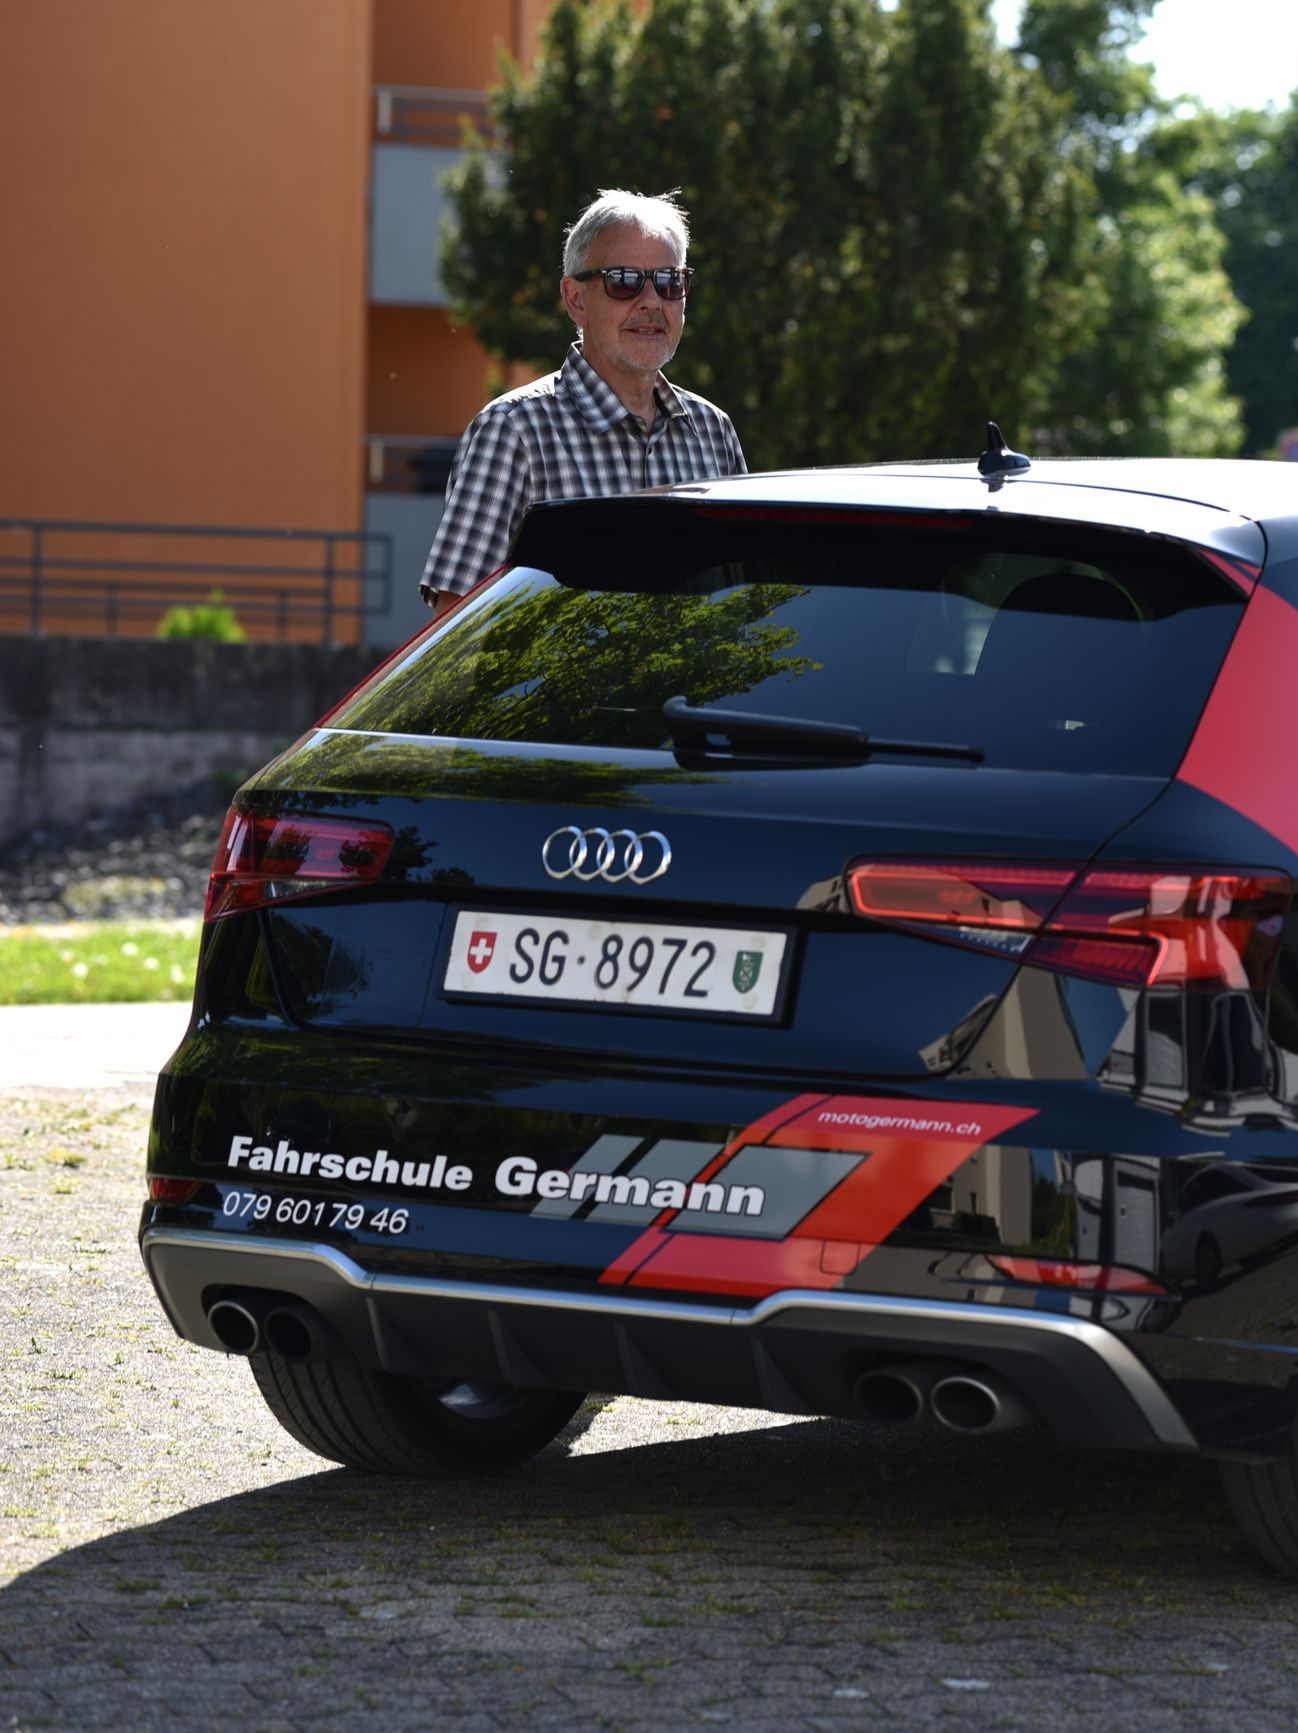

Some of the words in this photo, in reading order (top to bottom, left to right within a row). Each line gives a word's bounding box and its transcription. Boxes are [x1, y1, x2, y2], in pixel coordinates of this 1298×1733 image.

[817, 1111, 982, 1136] motogermann.ch
[227, 1135, 473, 1191] Fahrschule
[494, 1156, 766, 1217] Germann
[223, 1191, 272, 1219] 079
[370, 1207, 409, 1234] 46
